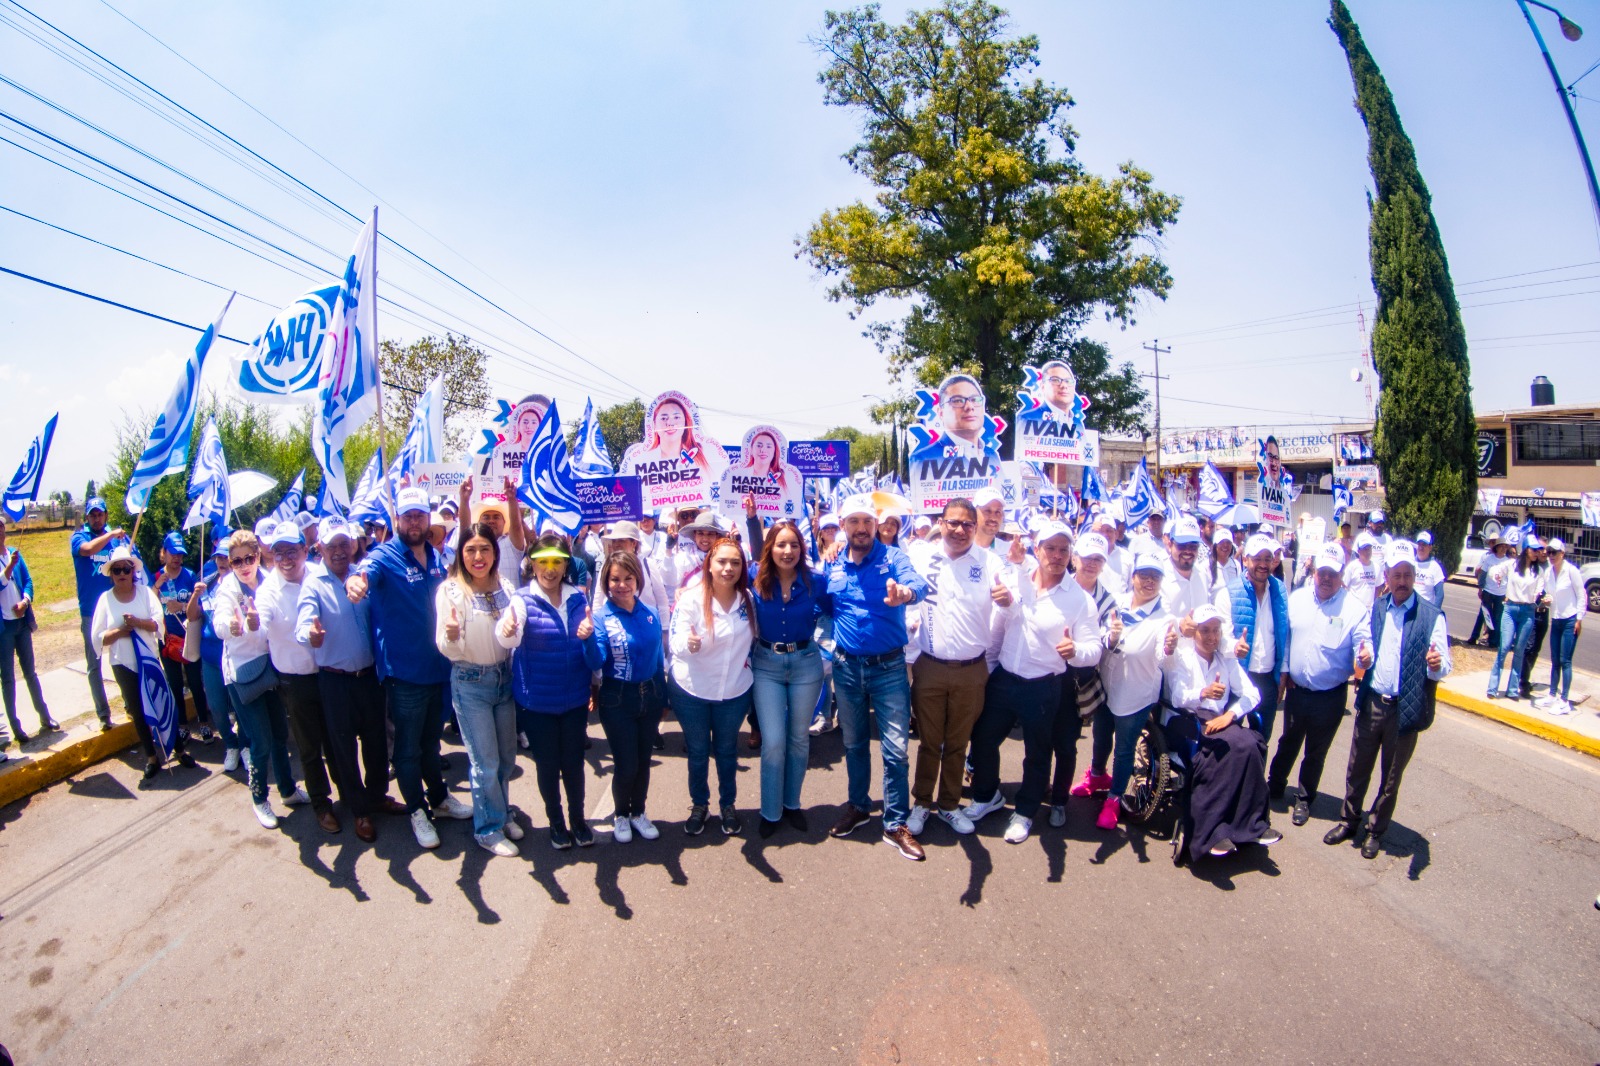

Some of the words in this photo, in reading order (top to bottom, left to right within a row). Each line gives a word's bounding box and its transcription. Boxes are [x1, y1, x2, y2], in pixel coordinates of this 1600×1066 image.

[1024, 419, 1077, 438] IVAN
[1025, 449, 1080, 460] PRESIDENTE
[635, 459, 679, 475] MARY
[920, 457, 989, 480] IVAN
[435, 471, 465, 479] ACCIÓN
[641, 468, 700, 486] MÉNDEZ
[732, 475, 765, 485] MARY
[732, 484, 780, 496] MÉNDEZ
[1262, 486, 1283, 504] IVAN
[652, 493, 703, 506] DIPUTADA
[1533, 499, 1564, 507] ZENTER
[742, 503, 780, 511] DUTADA
[924, 552, 943, 606] IVAN
